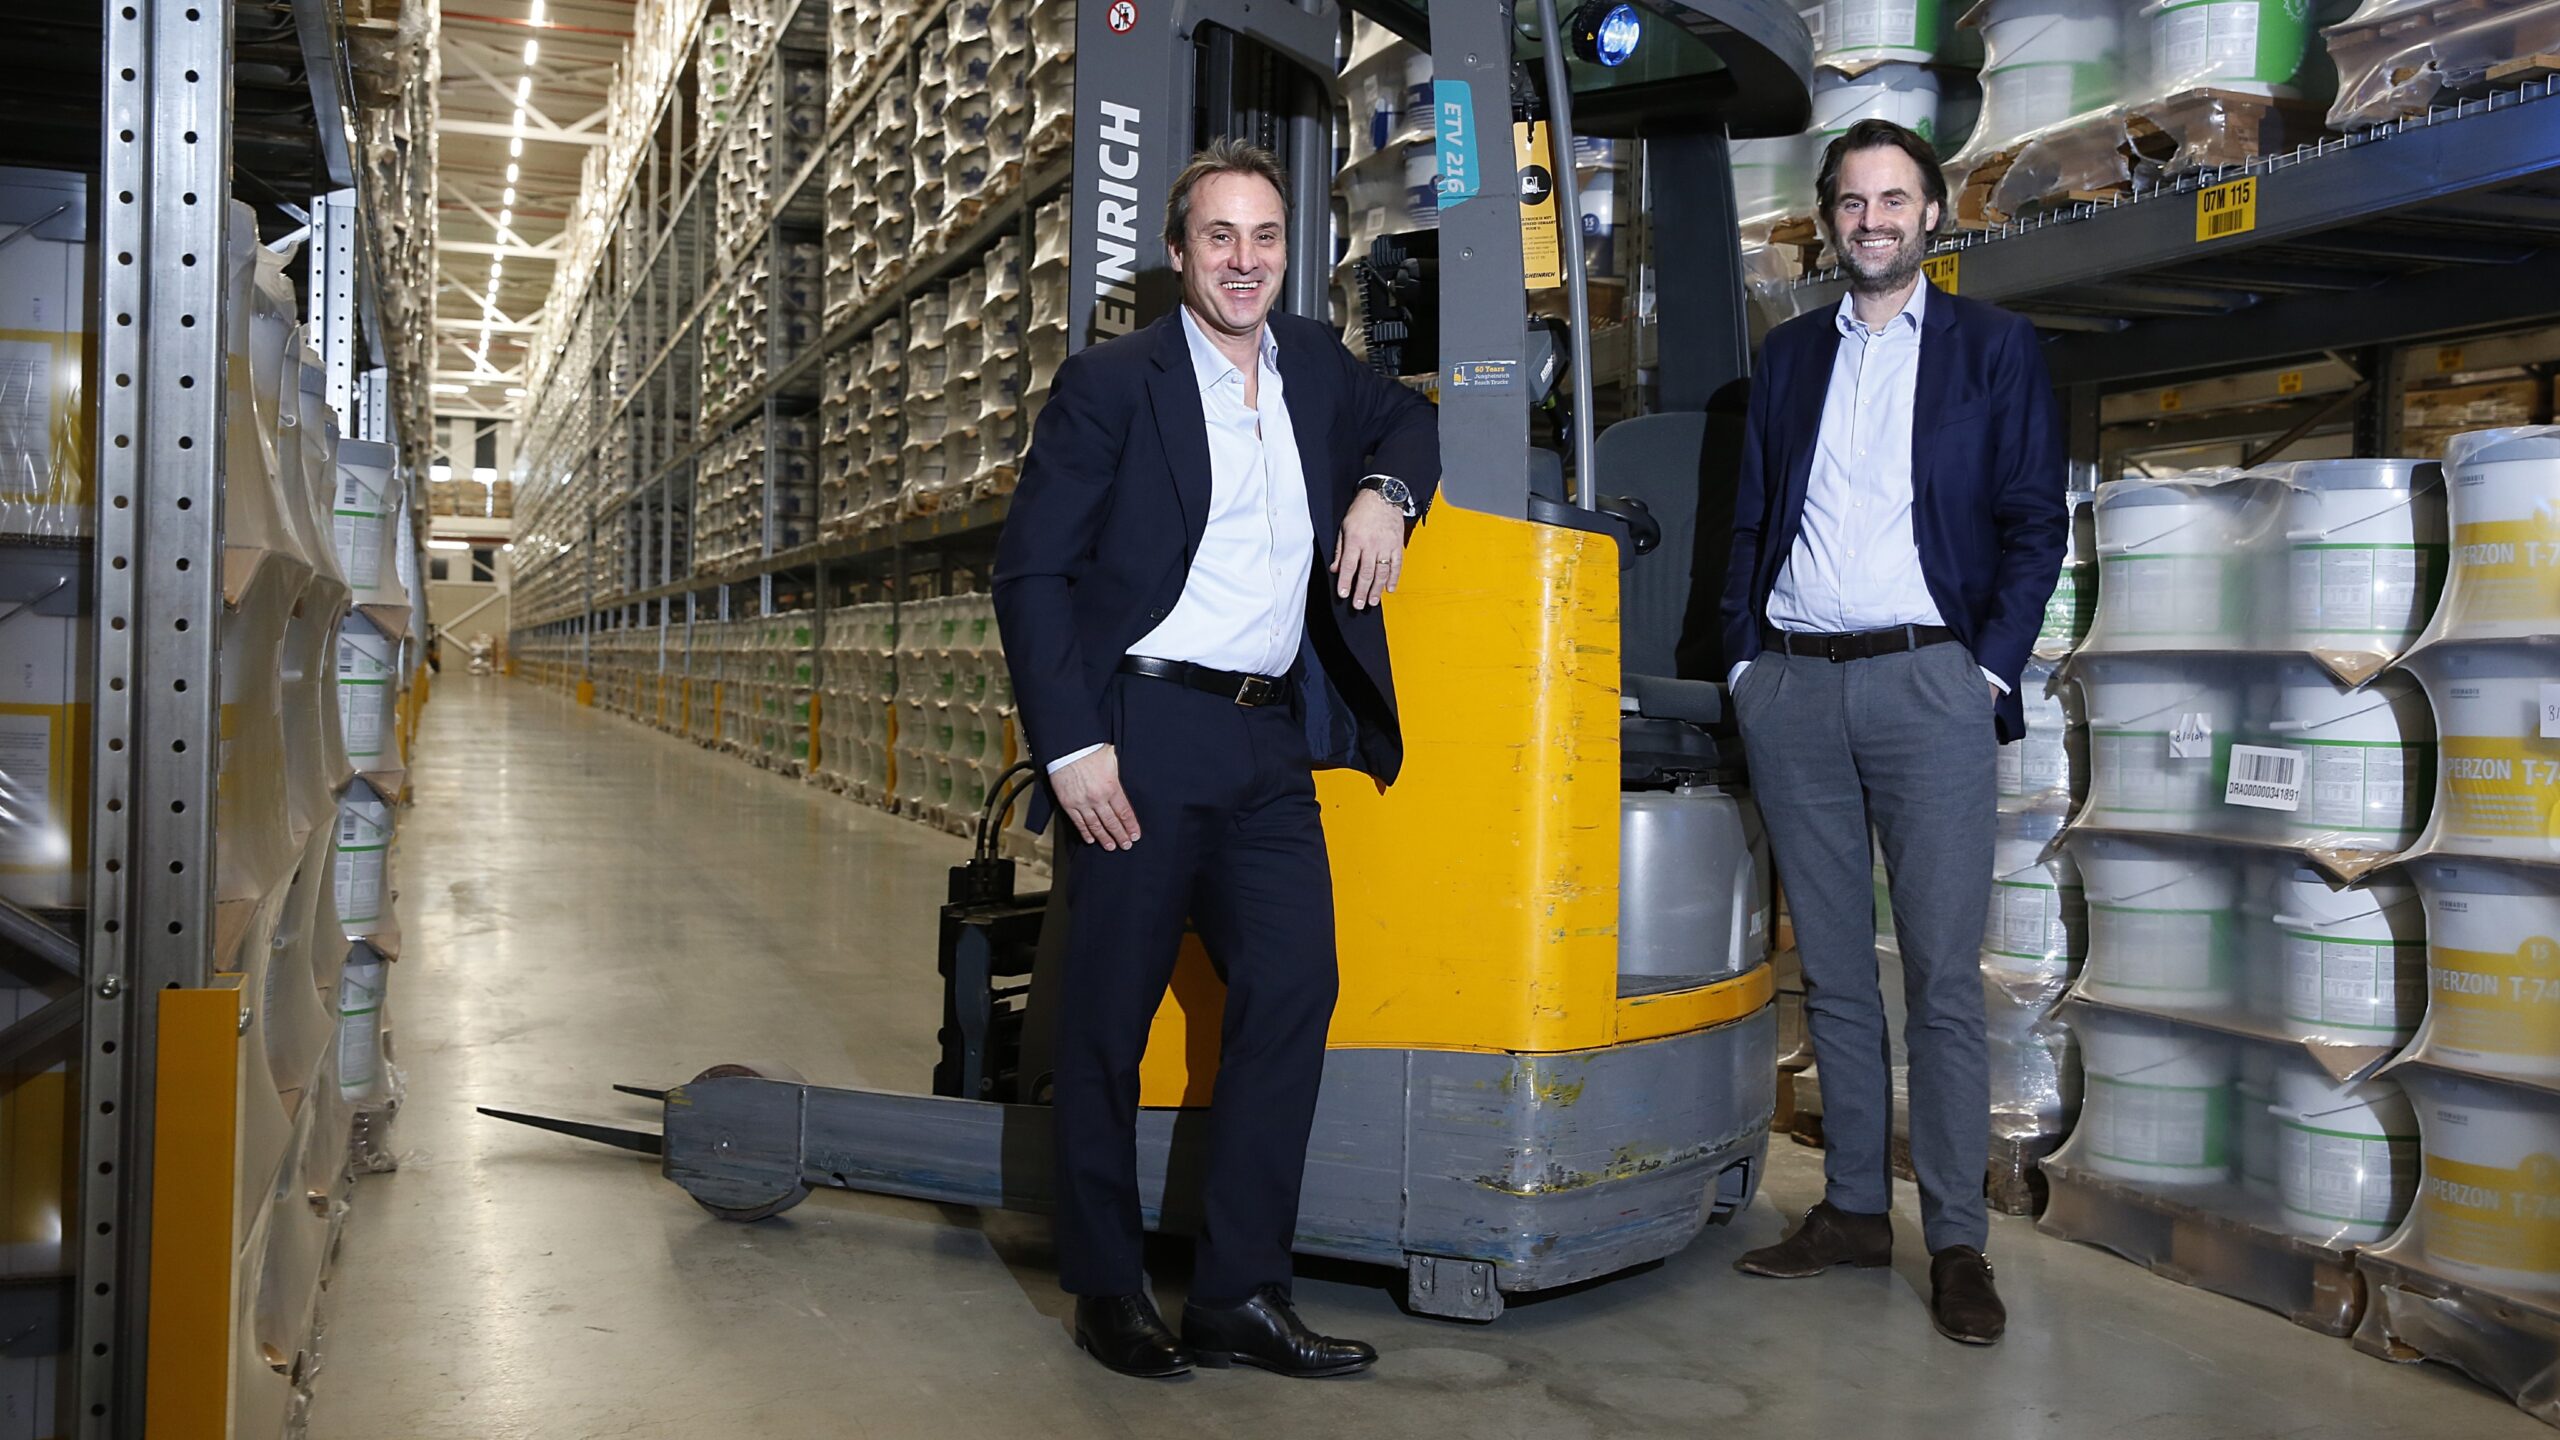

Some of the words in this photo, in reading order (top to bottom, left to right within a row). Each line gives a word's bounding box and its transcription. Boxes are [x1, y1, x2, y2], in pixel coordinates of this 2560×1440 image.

[1444, 102, 1464, 146] ETV
[1446, 151, 1465, 193] 216
[2230, 181, 2250, 207] 115
[1941, 257, 1954, 276] 114
[1474, 365, 1484, 373] 60
[1485, 365, 1505, 373] Years
[2521, 759, 2560, 786] T-7
[2433, 967, 2499, 997] PERZON
